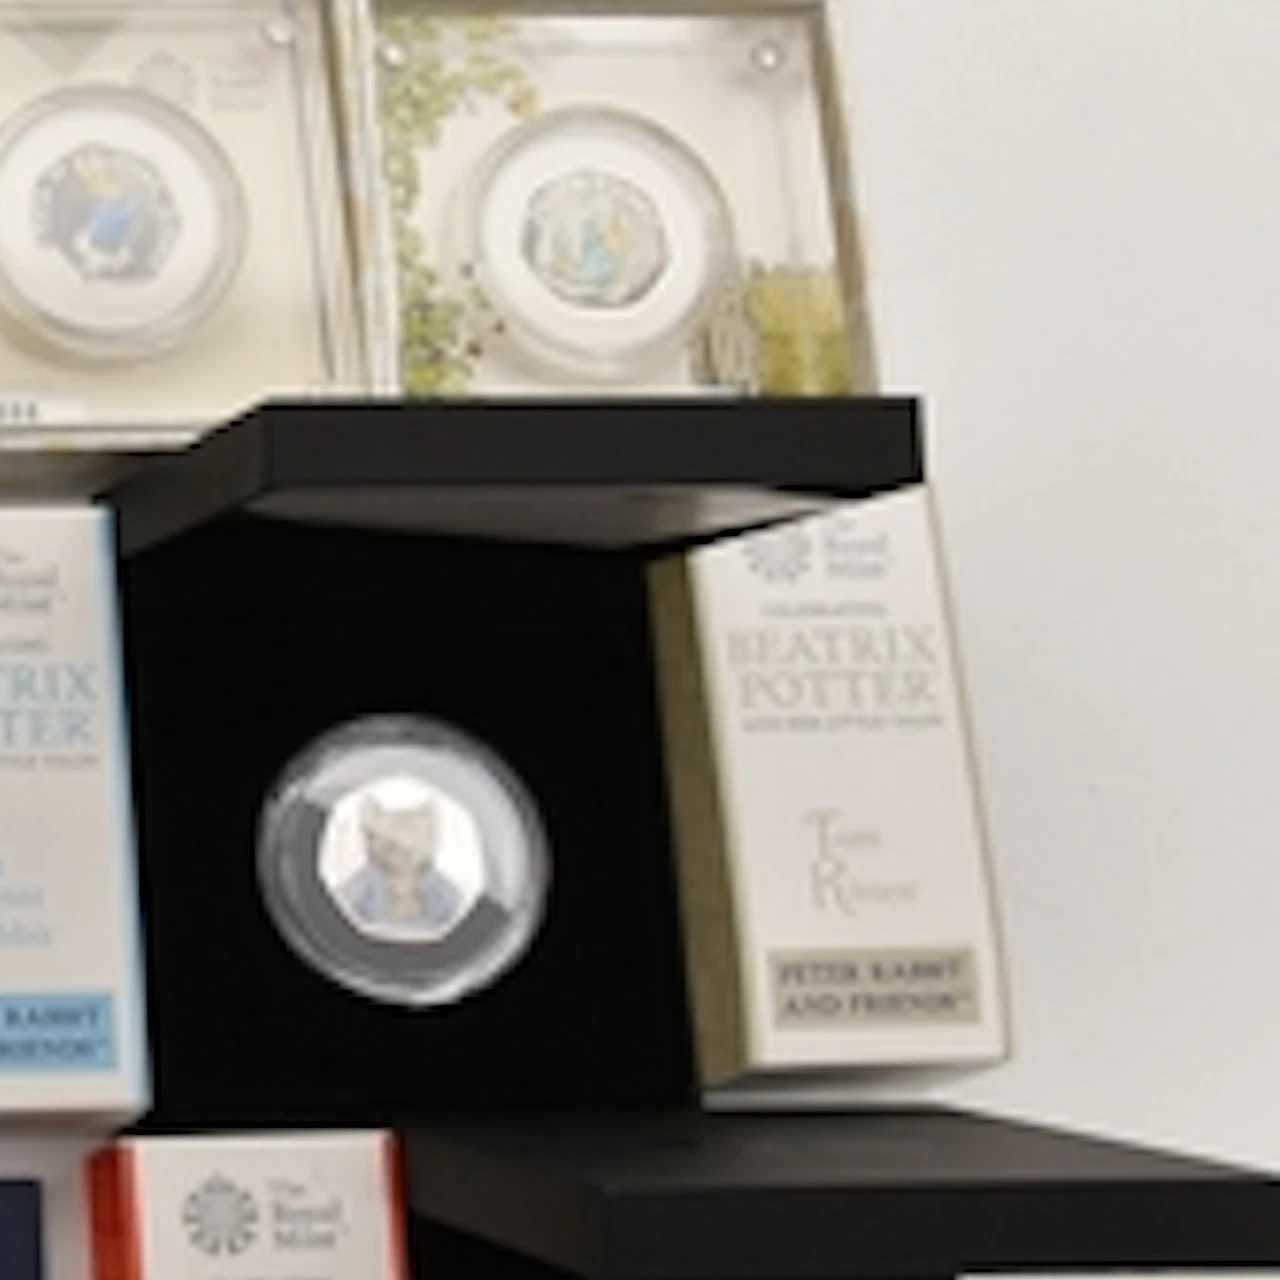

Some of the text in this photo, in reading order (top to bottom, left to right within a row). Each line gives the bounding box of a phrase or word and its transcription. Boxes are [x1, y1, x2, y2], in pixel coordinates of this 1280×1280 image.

[727, 624, 937, 667] BEATRIX
[740, 668, 939, 711] POTTER
[778, 961, 858, 986] PETER
[781, 993, 843, 1016] AND
